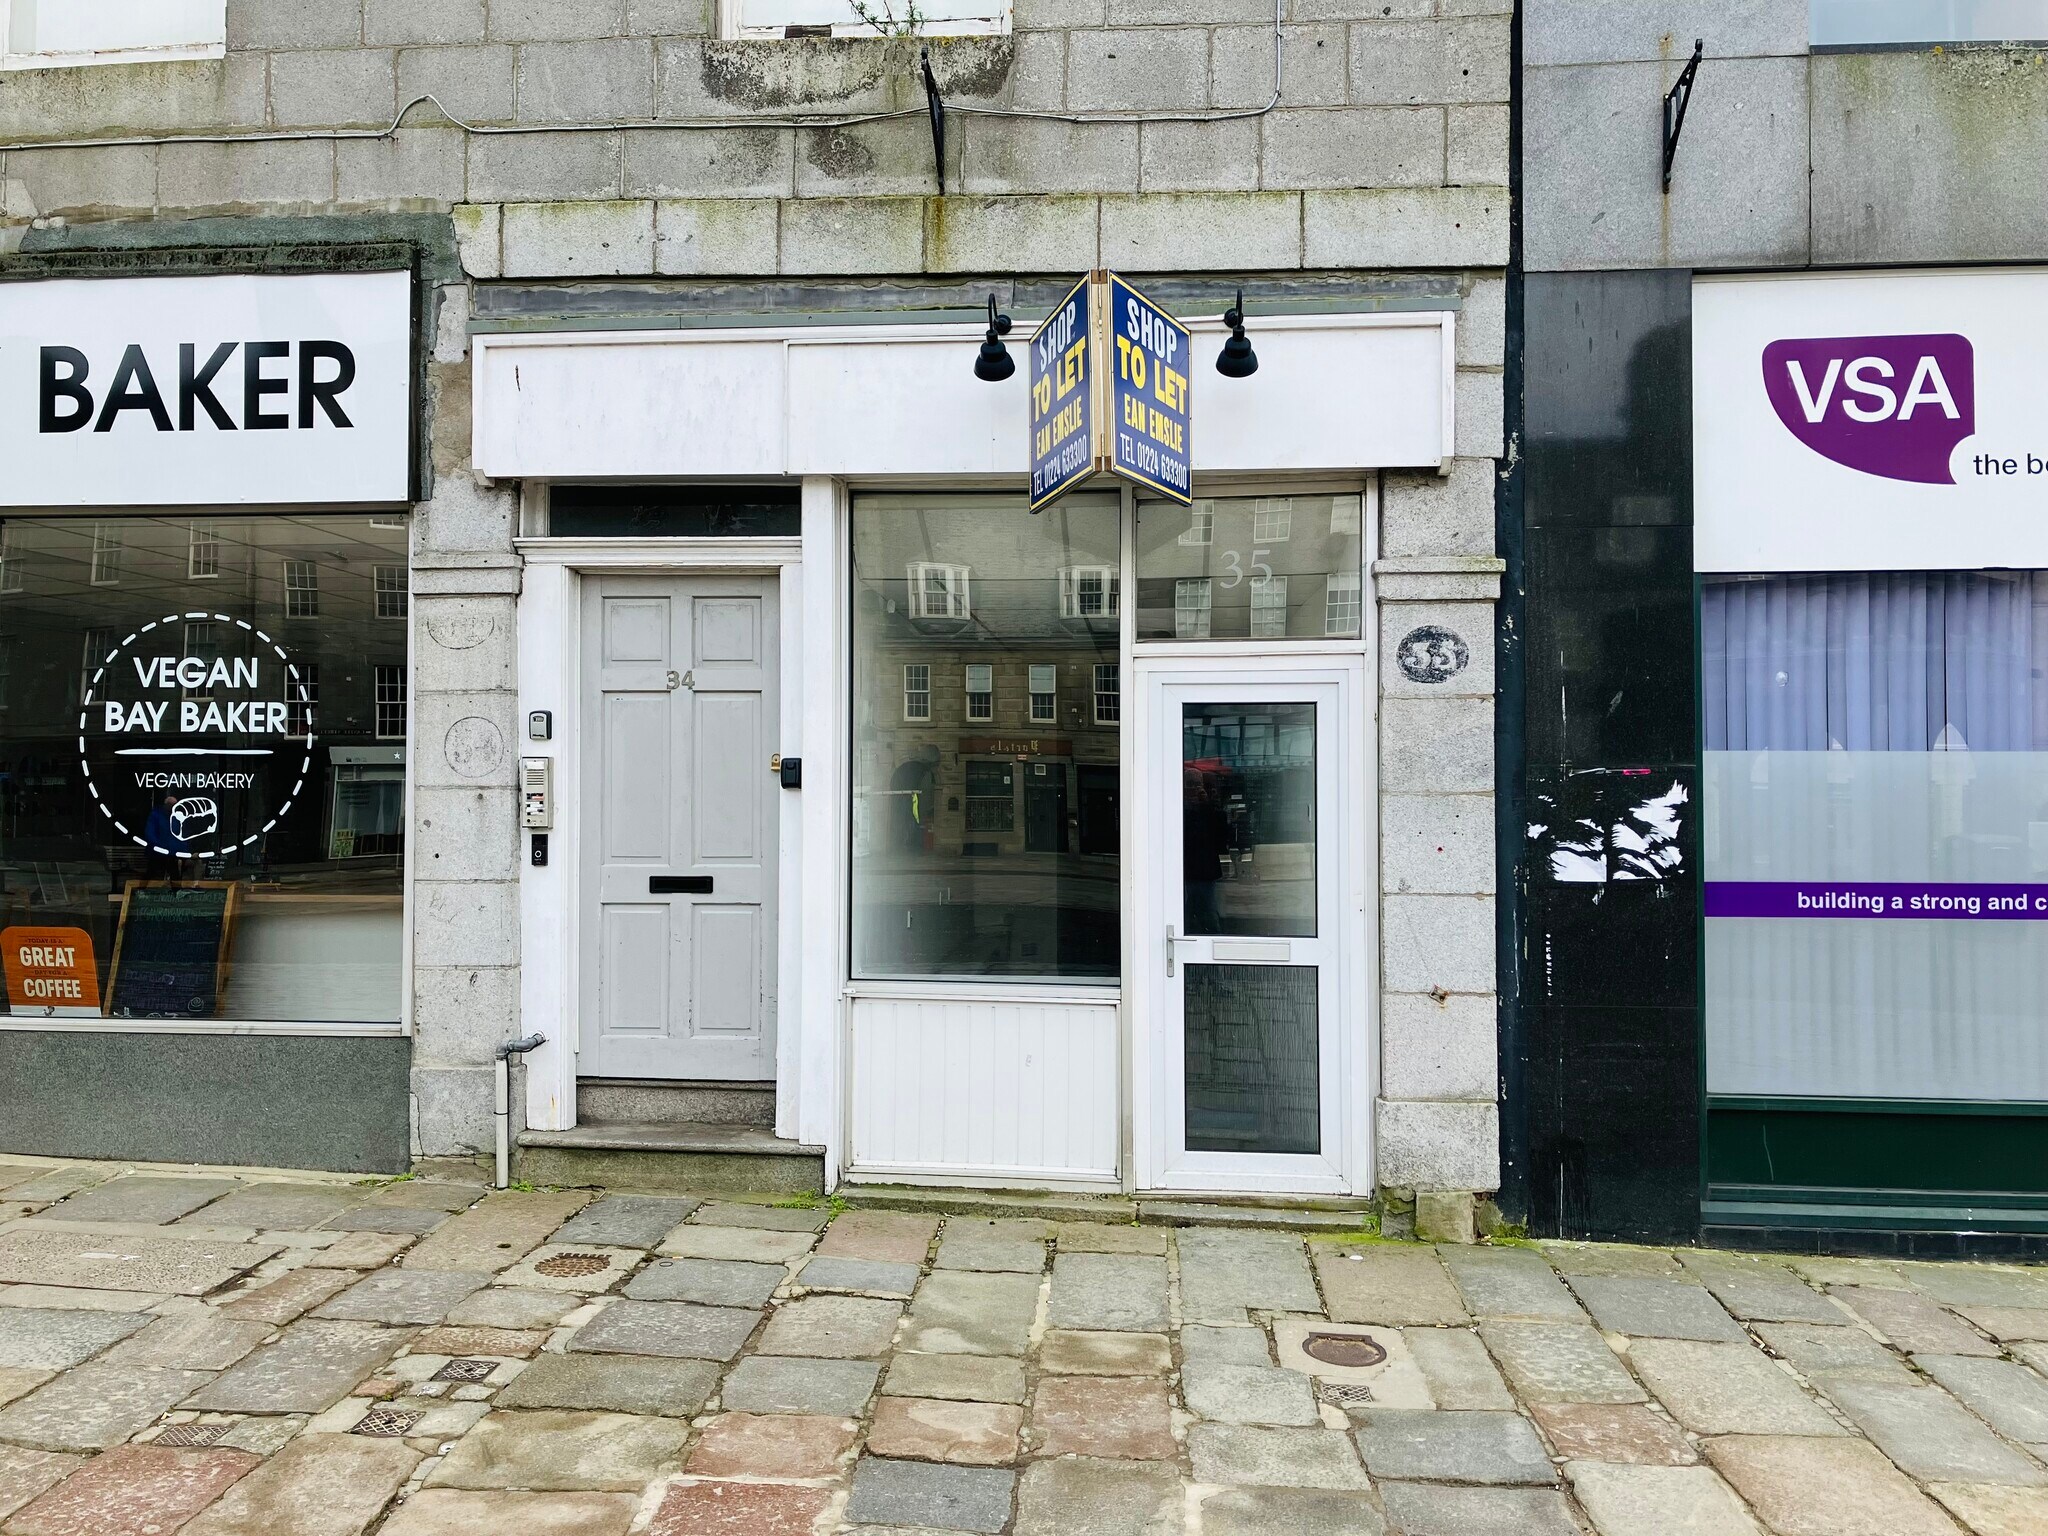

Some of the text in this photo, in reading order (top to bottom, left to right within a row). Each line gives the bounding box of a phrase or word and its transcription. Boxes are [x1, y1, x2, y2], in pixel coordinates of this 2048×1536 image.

[1039, 300, 1076, 373] SHOP
[1127, 298, 1177, 364] SHOP
[38, 340, 356, 433] BAKER
[1033, 335, 1086, 423] TO LET
[1117, 333, 1187, 415] TO LET
[1786, 355, 1961, 423] VSA
[1036, 395, 1083, 461] EAN EMSLIE
[1124, 392, 1183, 454] EAN EMSLIE
[1033, 434, 1087, 497] TEL 01224 633300
[1119, 432, 1187, 491] TEL 01224 633300
[1973, 453, 2048, 475] the b
[1219, 549, 1273, 589] 35
[133, 657, 258, 688] VEGAN
[666, 670, 696, 690] 34
[105, 701, 287, 733] BAY BAKER
[134, 772, 255, 789] VEGAN BAKERY
[1797, 891, 1885, 913] building
[1891, 896, 1903, 910] a
[1910, 893, 1981, 914] strong
[1987, 893, 2028, 910] and
[19, 946, 75, 968] GREAT
[23, 978, 82, 999] COFFEE
